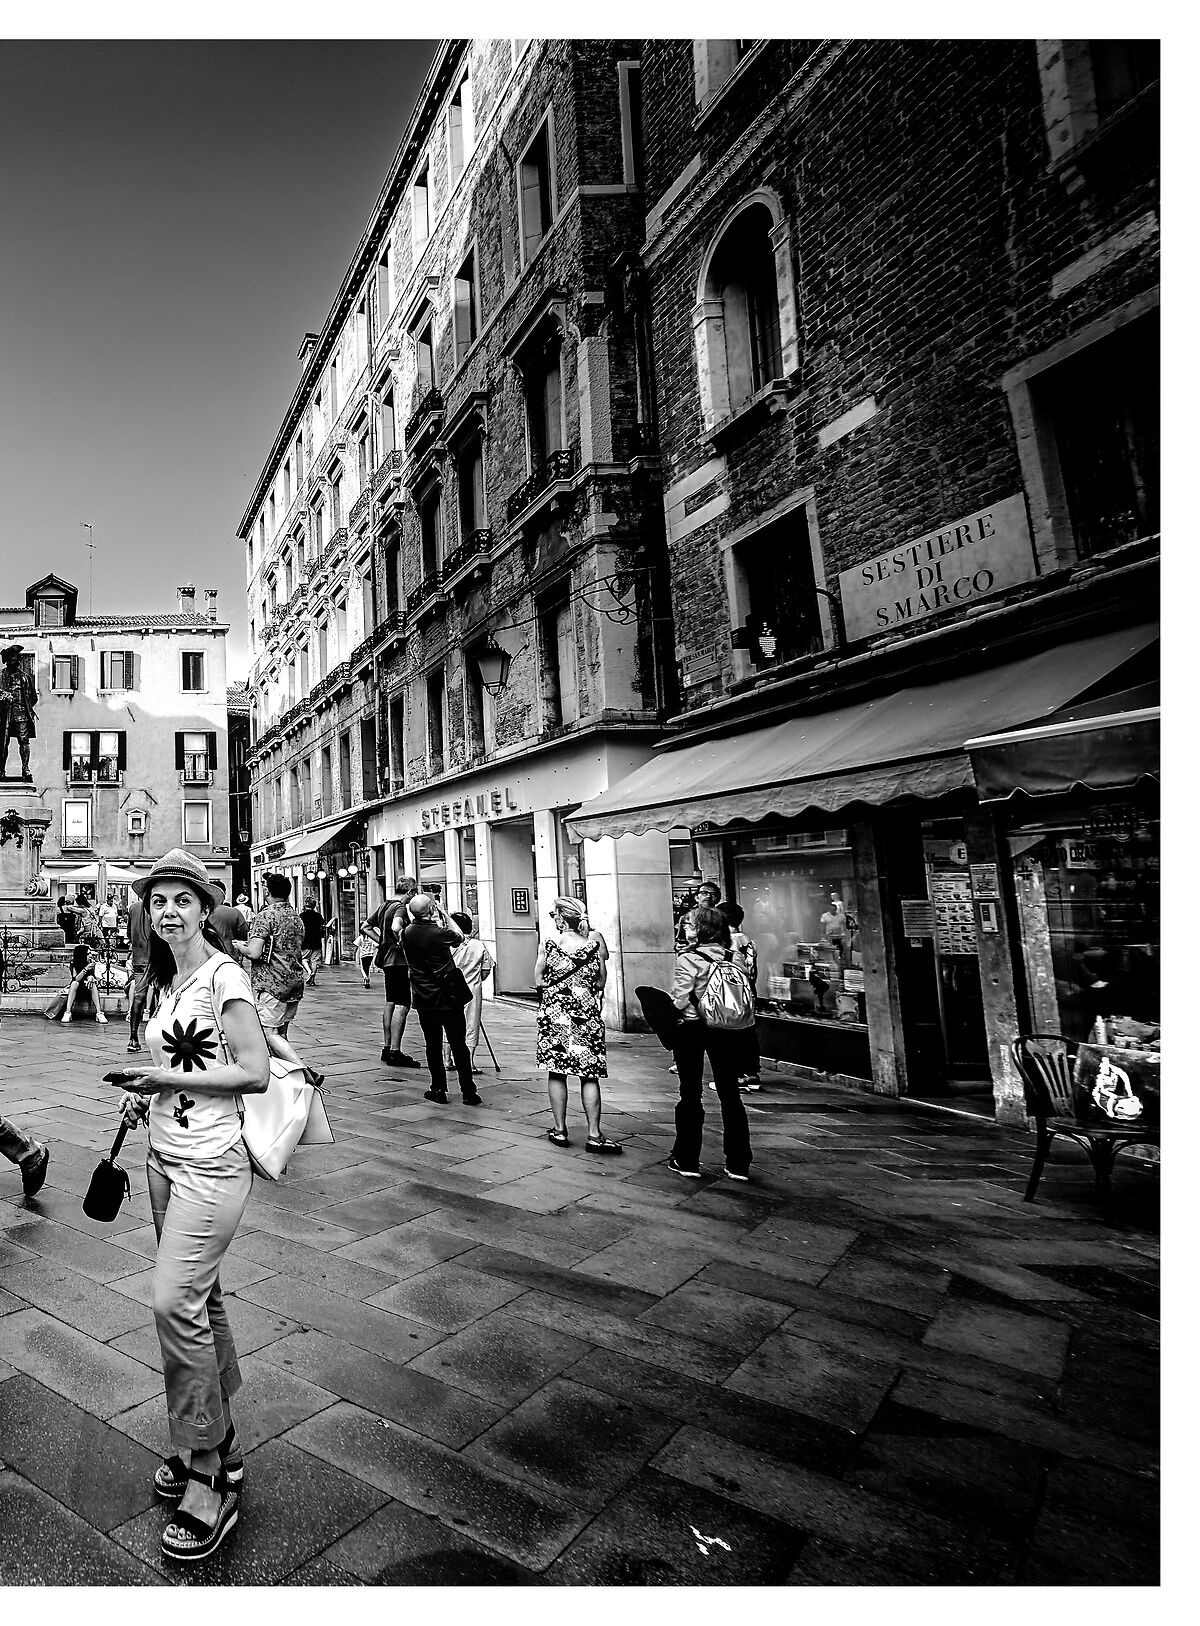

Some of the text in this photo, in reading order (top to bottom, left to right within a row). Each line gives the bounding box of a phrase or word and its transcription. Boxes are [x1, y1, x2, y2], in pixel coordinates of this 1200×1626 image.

[861, 513, 996, 586] SESTIERE
[915, 560, 944, 590] DI
[422, 787, 518, 829] STEFANEL
